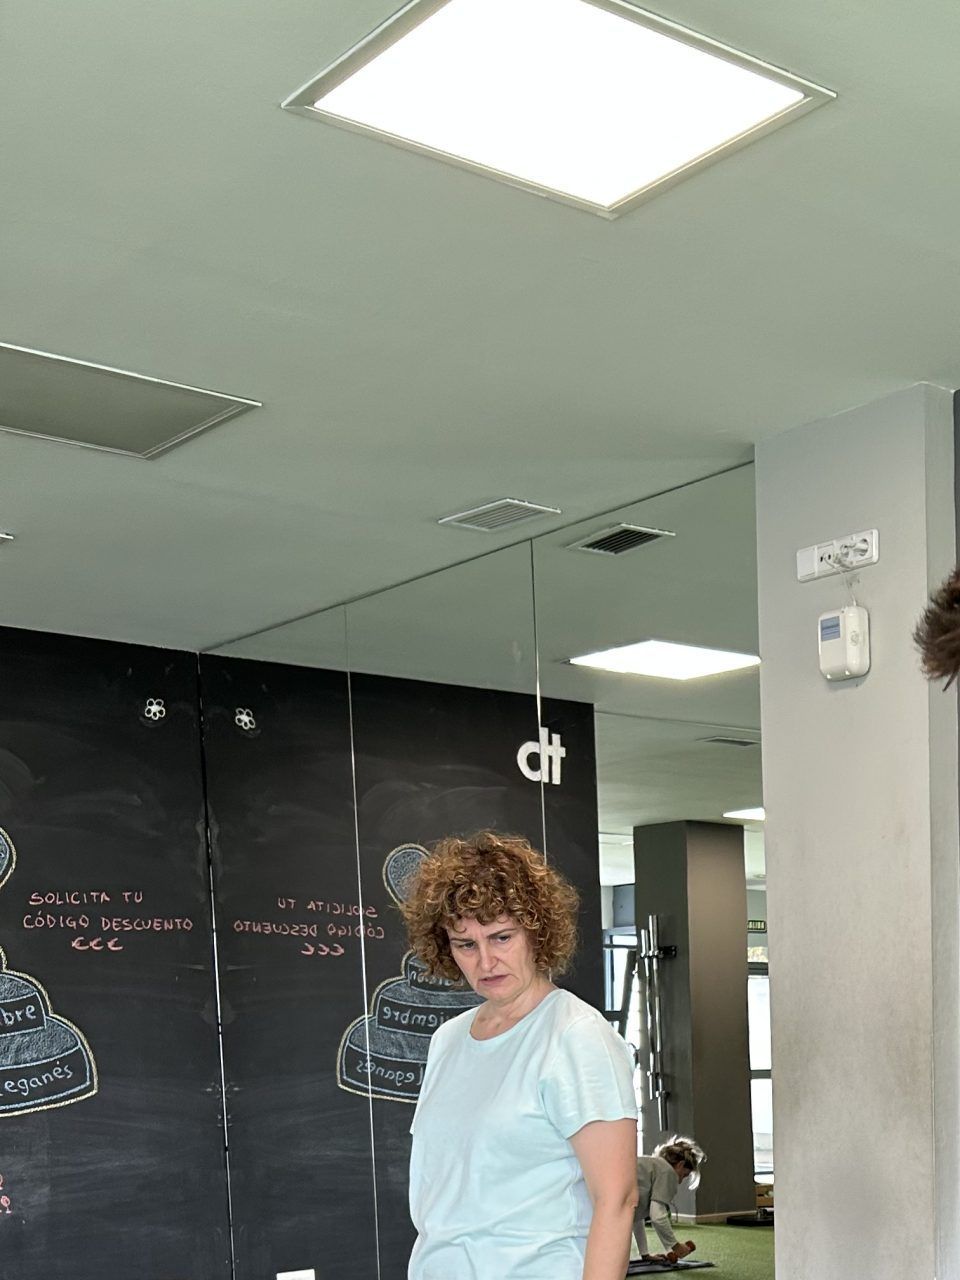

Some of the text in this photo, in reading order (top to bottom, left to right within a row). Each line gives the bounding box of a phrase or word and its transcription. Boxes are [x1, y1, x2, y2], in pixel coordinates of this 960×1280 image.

[29, 891, 143, 905] SOLICITA TU
[23, 910, 194, 932] CÓDIGO DESCUENTO
[0, 1061, 73, 1096] eganés
